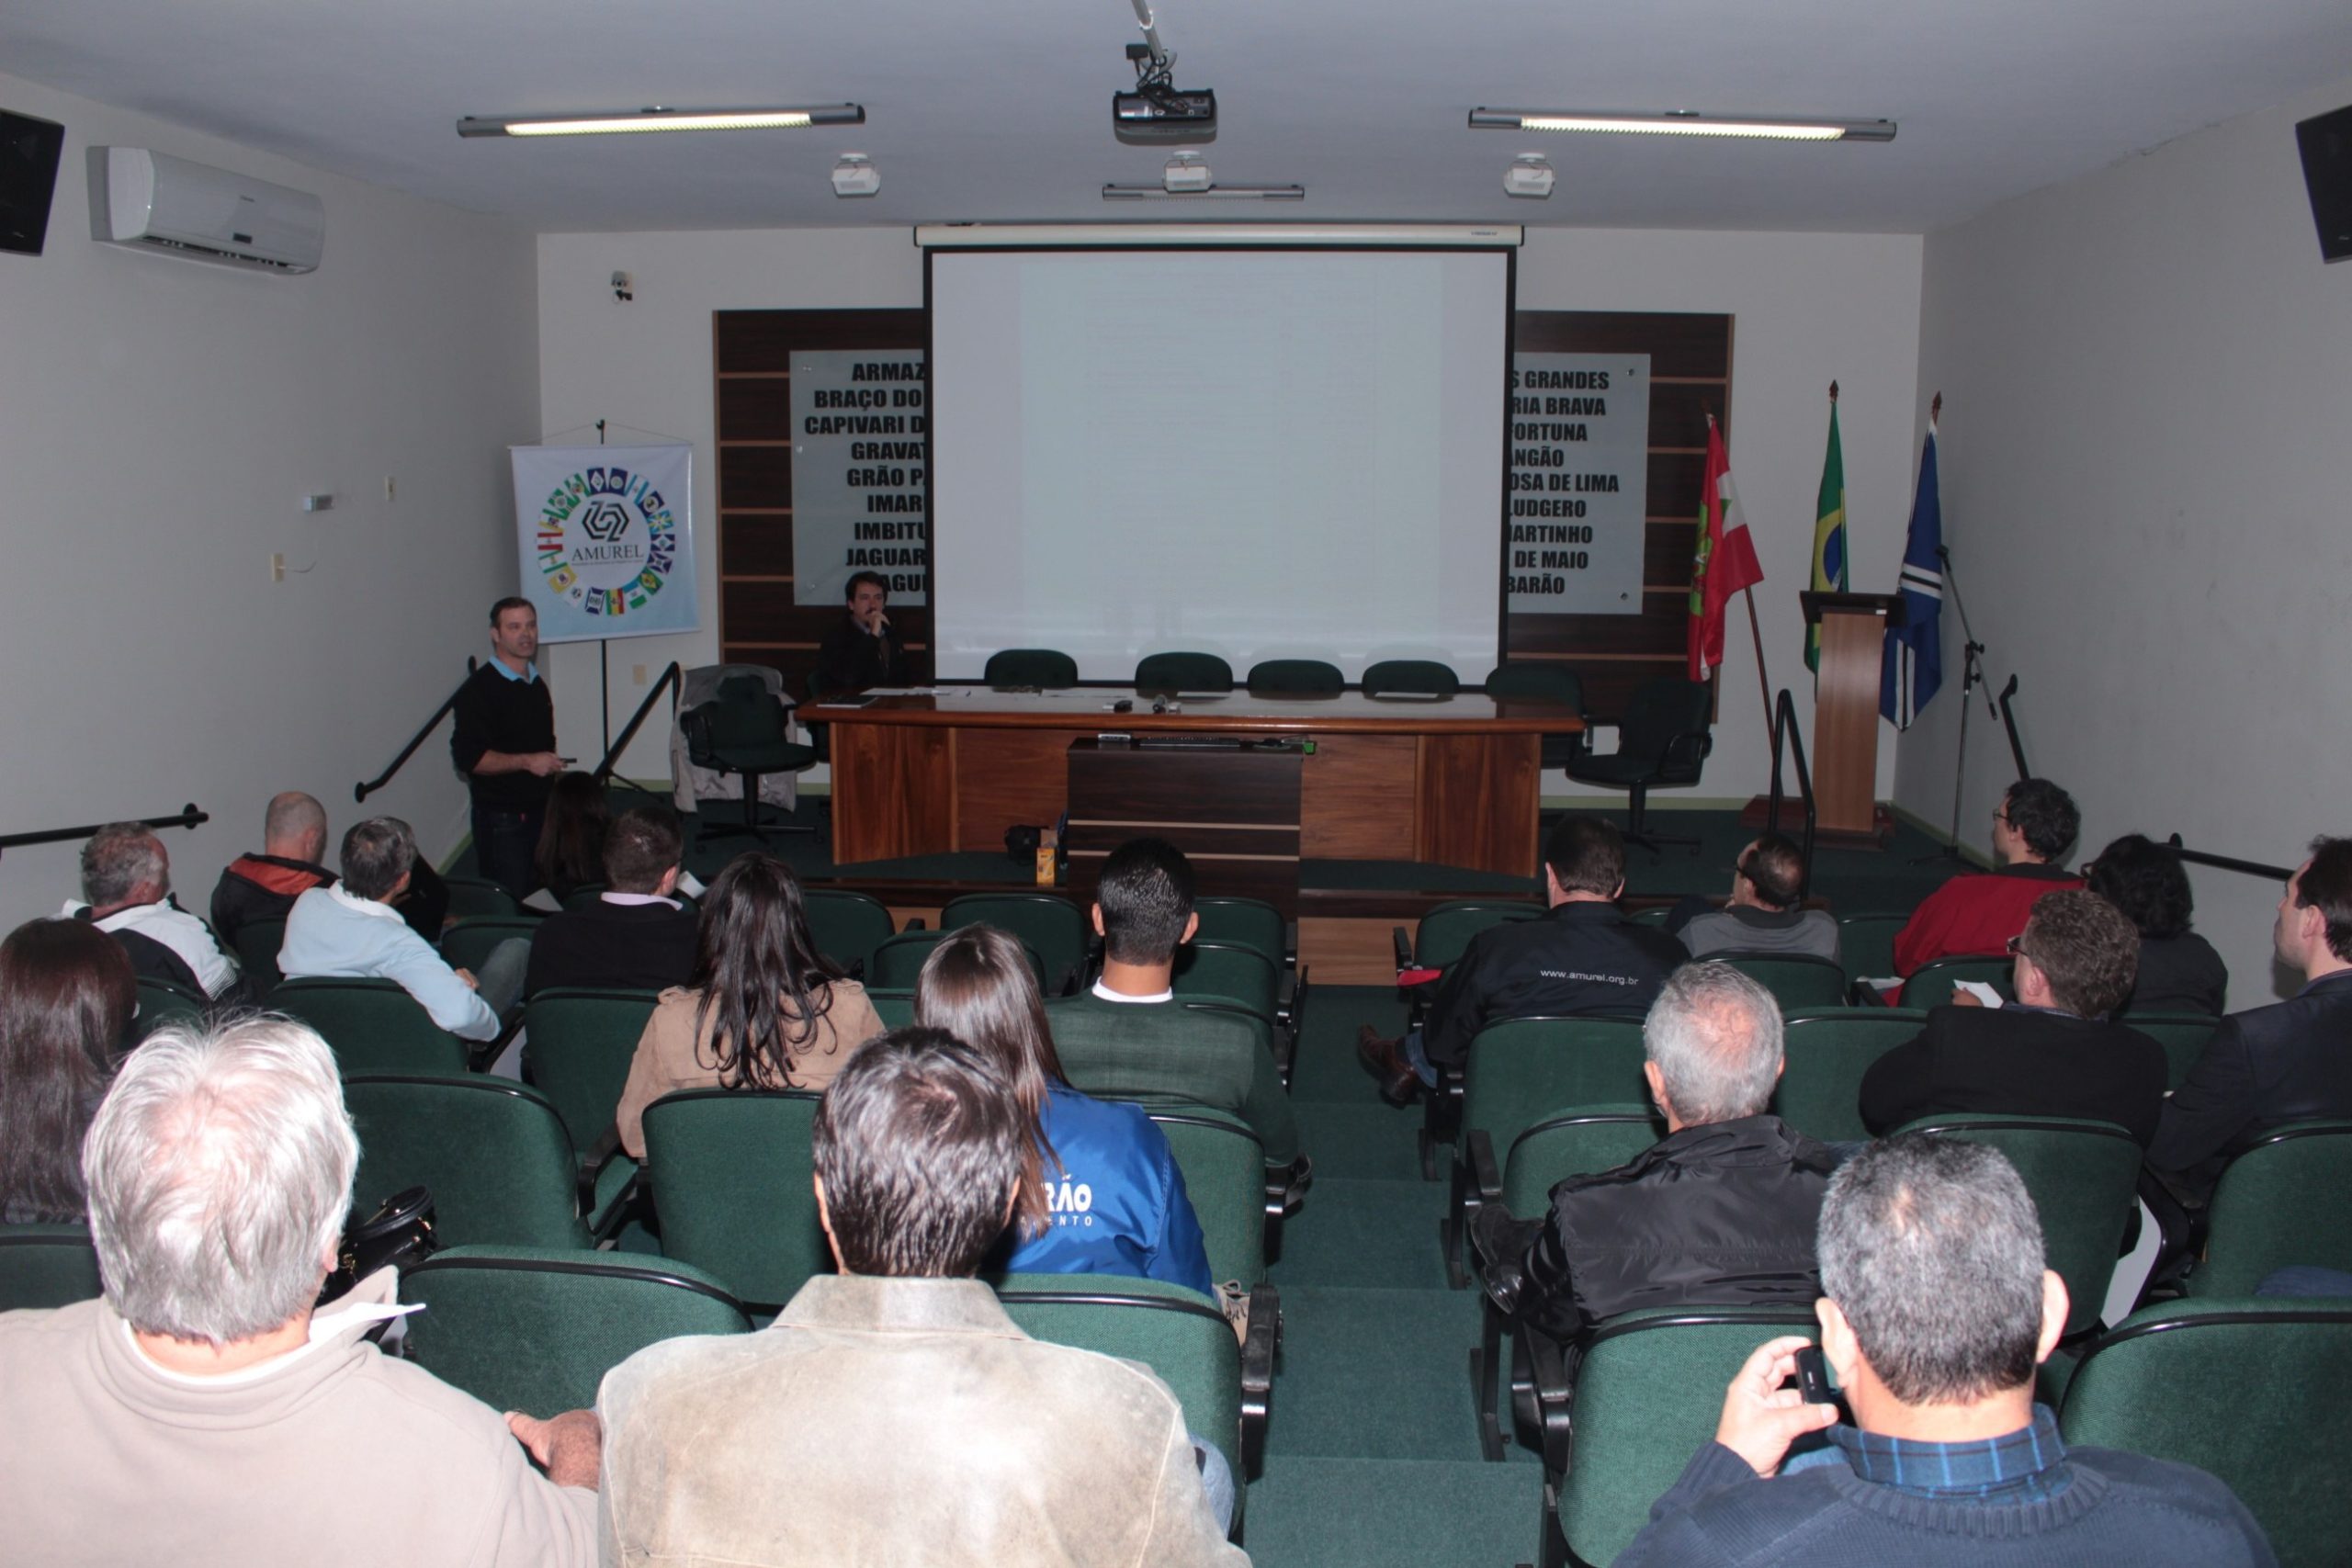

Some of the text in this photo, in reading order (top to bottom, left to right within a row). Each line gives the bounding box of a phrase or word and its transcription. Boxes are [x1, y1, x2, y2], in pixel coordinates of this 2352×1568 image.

[1525, 370, 1610, 389] GRANDES
[814, 389, 922, 412] BRAÇO DO
[1545, 397, 1606, 415] BRAVA
[805, 415, 905, 435] CAPIVARI
[1511, 423, 1588, 441] ORTUNA
[1511, 446, 1564, 468] NGÃO
[846, 465, 904, 487] GRÃO
[1548, 473, 1570, 491] DE
[1576, 474, 1620, 492] LIMA
[1510, 499, 1587, 518] UDGERO
[1509, 525, 1593, 544] ARTINHO
[571, 545, 645, 562] AMUREL
[1514, 550, 1589, 570] DE MAIO
[1540, 969, 1639, 986] www.amurel.org.br
